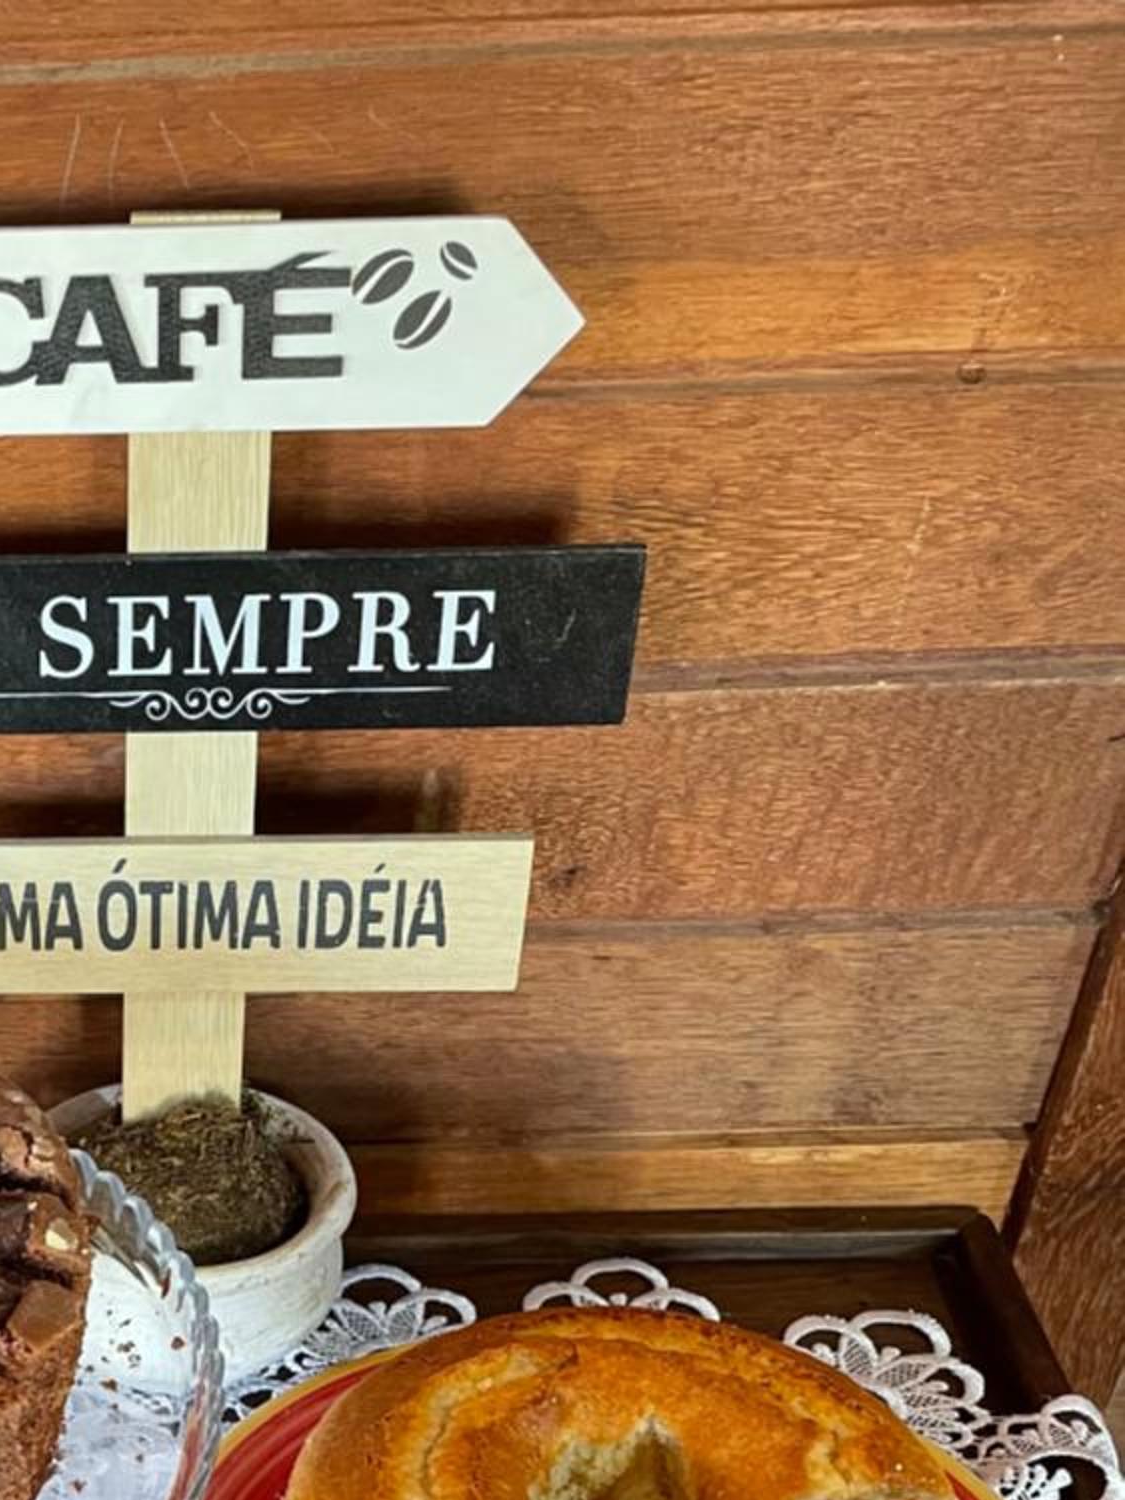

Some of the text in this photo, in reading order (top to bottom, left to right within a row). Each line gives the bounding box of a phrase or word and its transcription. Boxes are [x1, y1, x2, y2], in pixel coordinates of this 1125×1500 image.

[39, 589, 498, 681] SEMPRE
[98, 859, 281, 952] ÓTIMA
[296, 865, 448, 950] IDÉIA
